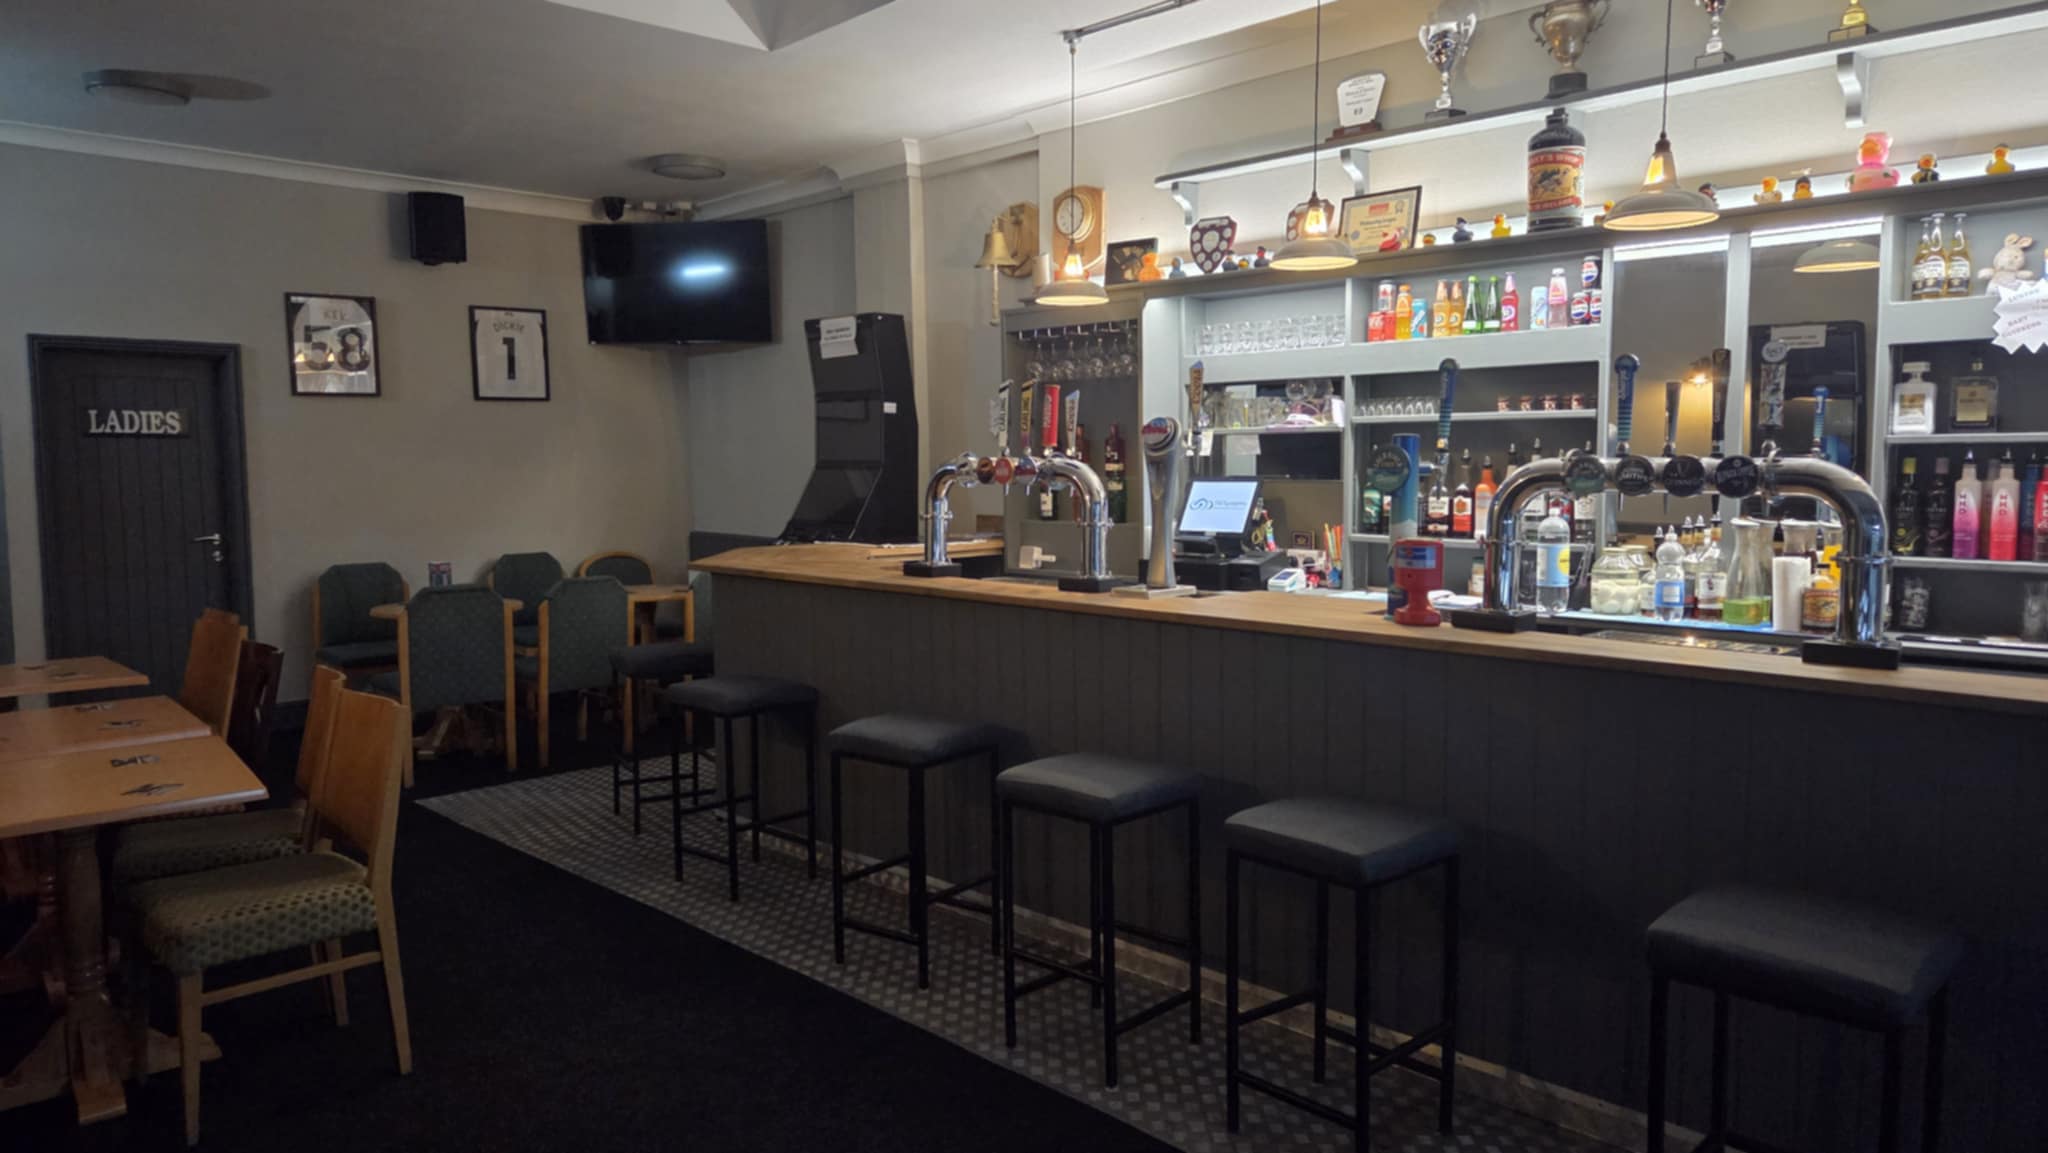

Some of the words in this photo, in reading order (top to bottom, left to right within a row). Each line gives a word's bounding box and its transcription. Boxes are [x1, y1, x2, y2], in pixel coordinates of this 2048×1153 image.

[303, 324, 371, 372] 58
[502, 336, 516, 381] 1
[87, 408, 181, 435] LADIES
